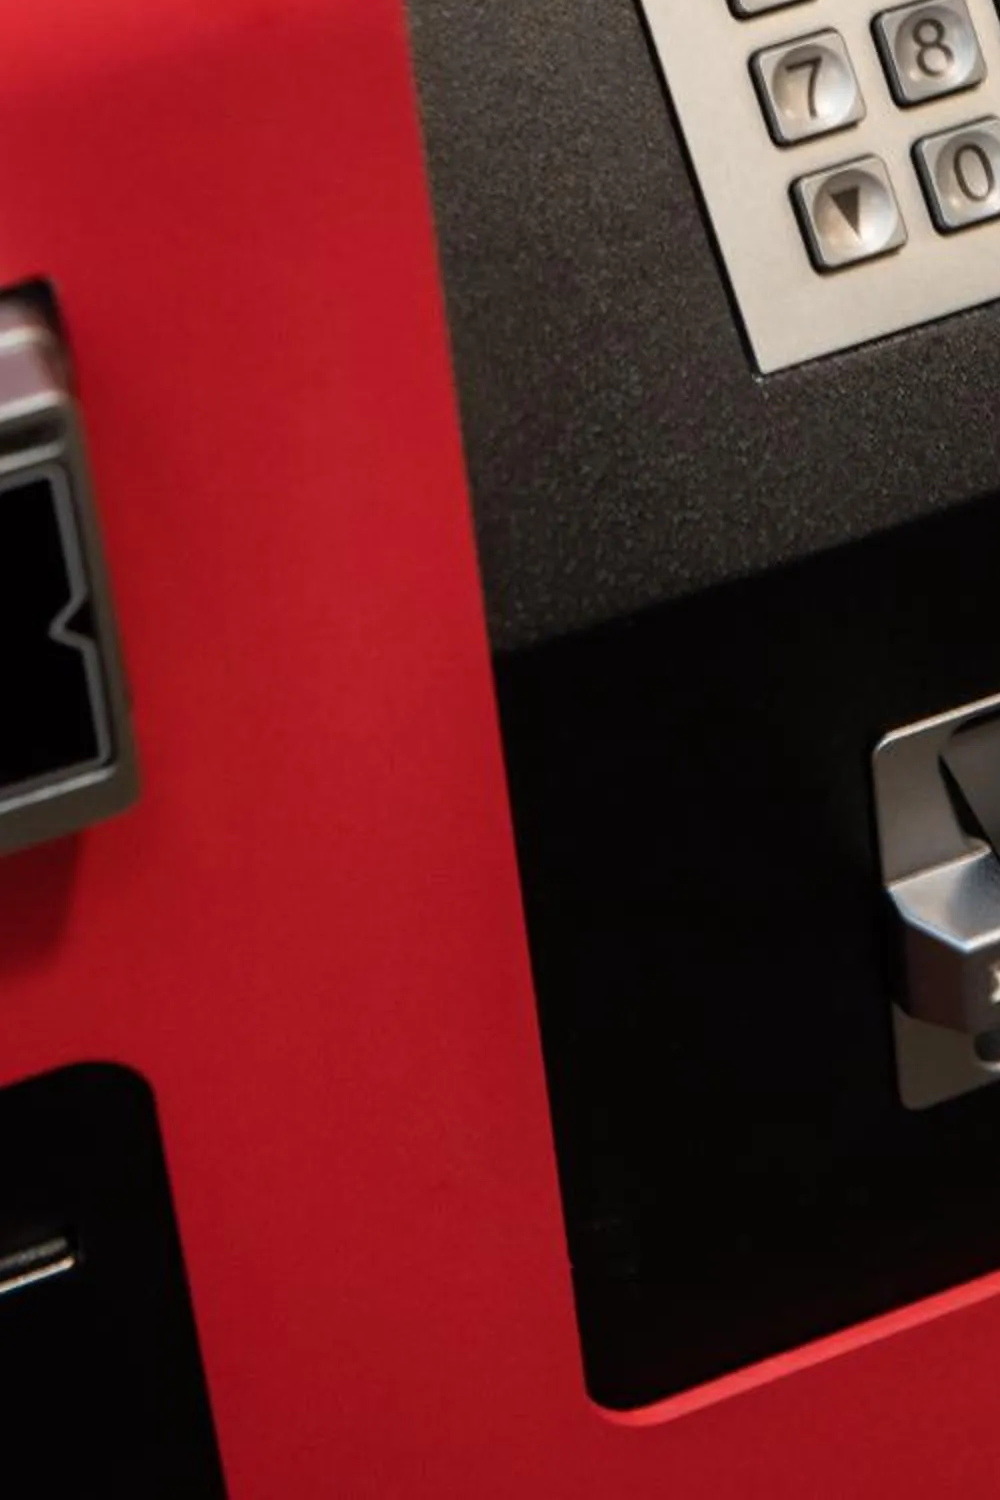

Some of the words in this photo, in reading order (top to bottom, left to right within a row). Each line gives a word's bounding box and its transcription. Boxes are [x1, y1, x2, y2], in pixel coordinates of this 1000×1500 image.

[911, 17, 956, 78] 8
[785, 55, 824, 119] 7
[953, 143, 996, 202] 0
